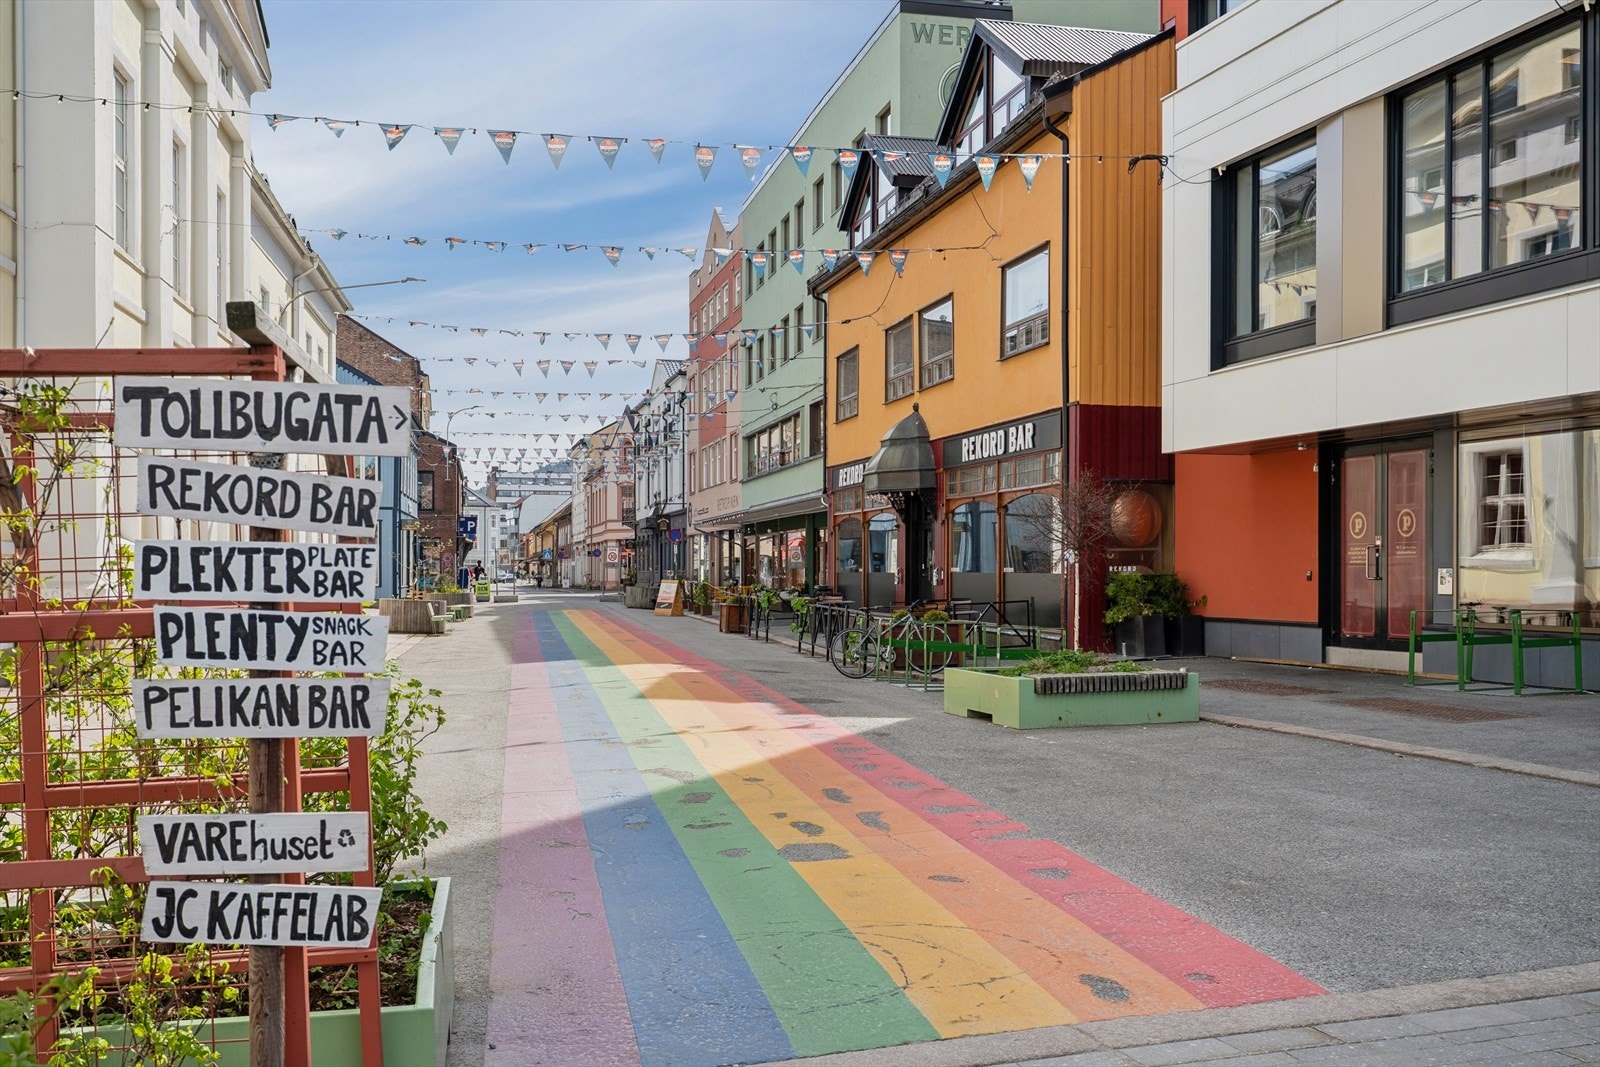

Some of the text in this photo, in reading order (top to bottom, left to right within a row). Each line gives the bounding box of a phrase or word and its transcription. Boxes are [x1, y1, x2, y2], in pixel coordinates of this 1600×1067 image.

[122, 386, 388, 444] TOLLBUGATA
[962, 422, 1035, 463] REKORD BAR
[147, 464, 376, 529] REKORD BAR
[838, 463, 864, 488] REKORD
[467, 521, 476, 531] P
[140, 545, 310, 594] PLEKTER
[308, 546, 376, 569] PLATE
[313, 569, 365, 598] BAR
[159, 612, 310, 662] PLENTY
[312, 616, 373, 637] SNACK
[312, 639, 367, 667] BAR
[143, 684, 371, 730] PELIKAN BAR
[153, 819, 334, 864] VAREhuset
[151, 887, 370, 942] JC KAFFELAB
